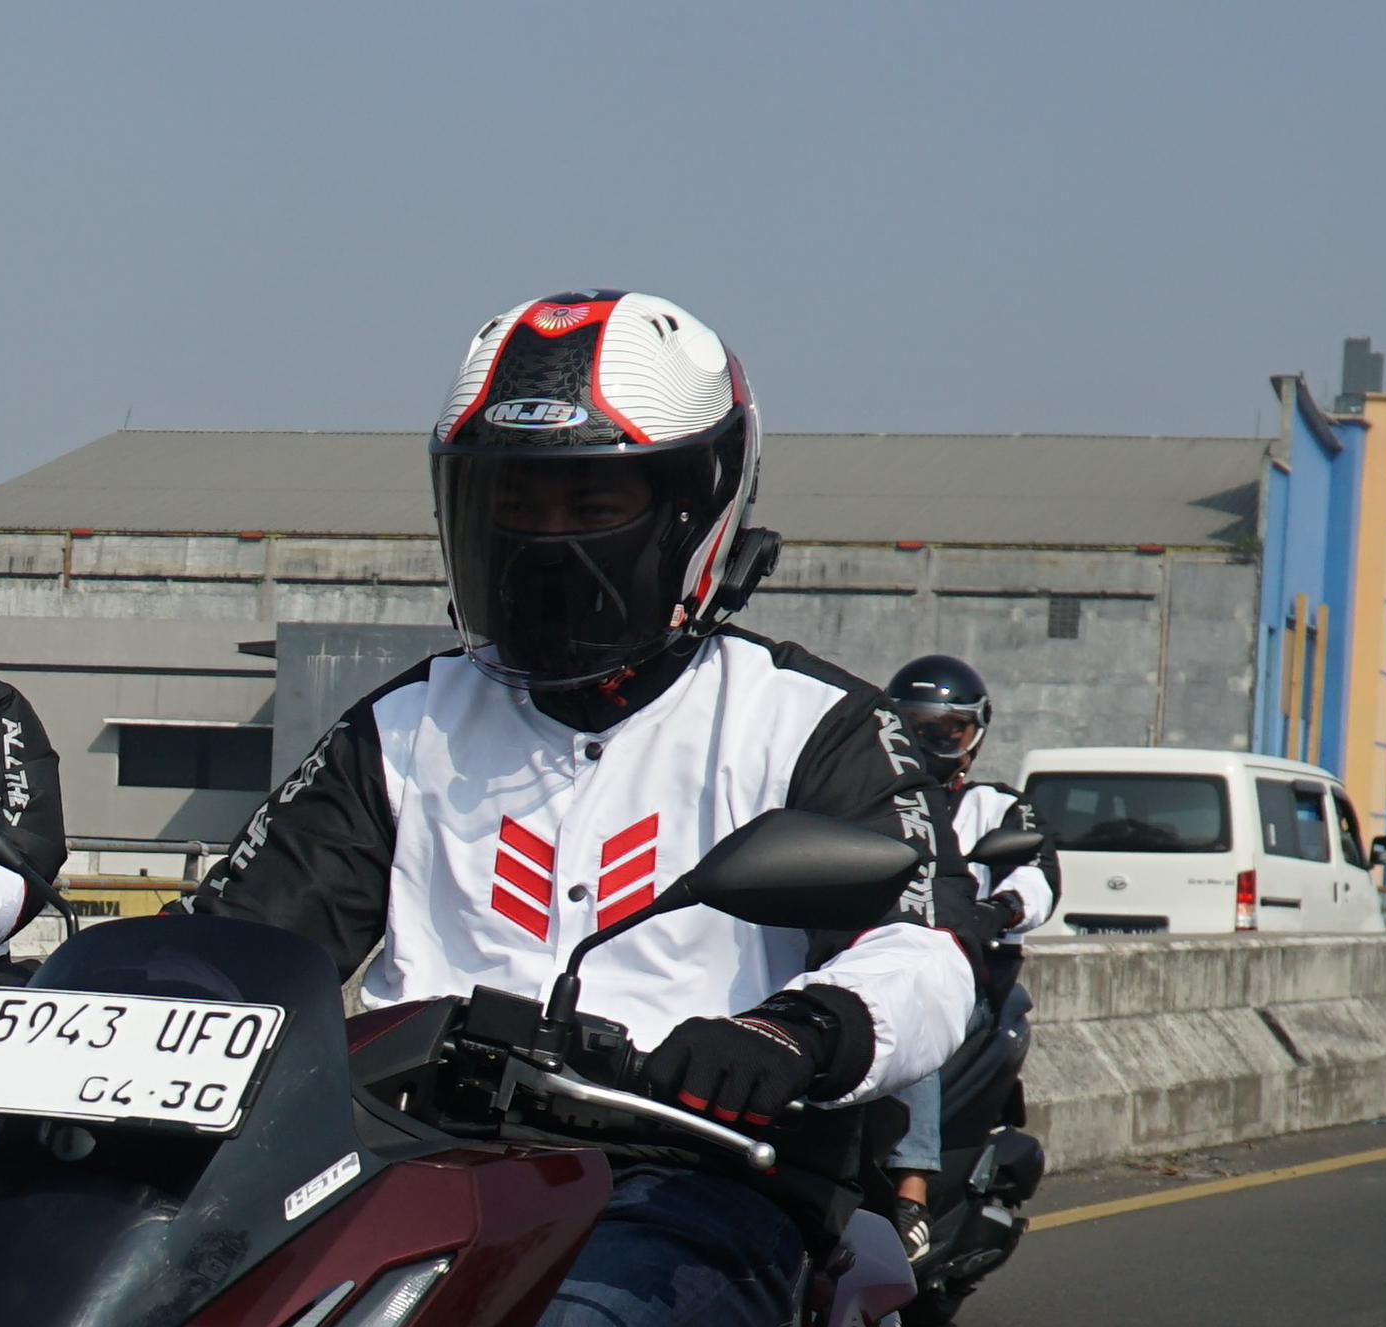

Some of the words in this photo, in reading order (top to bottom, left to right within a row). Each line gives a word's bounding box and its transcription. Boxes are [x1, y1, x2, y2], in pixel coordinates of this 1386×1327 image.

[493, 404, 575, 422] NJS
[1, 717, 25, 770] ALL
[874, 707, 921, 776] ALL
[4, 769, 31, 810] THE
[894, 791, 938, 857] THE
[155, 1008, 264, 1060] UFO
